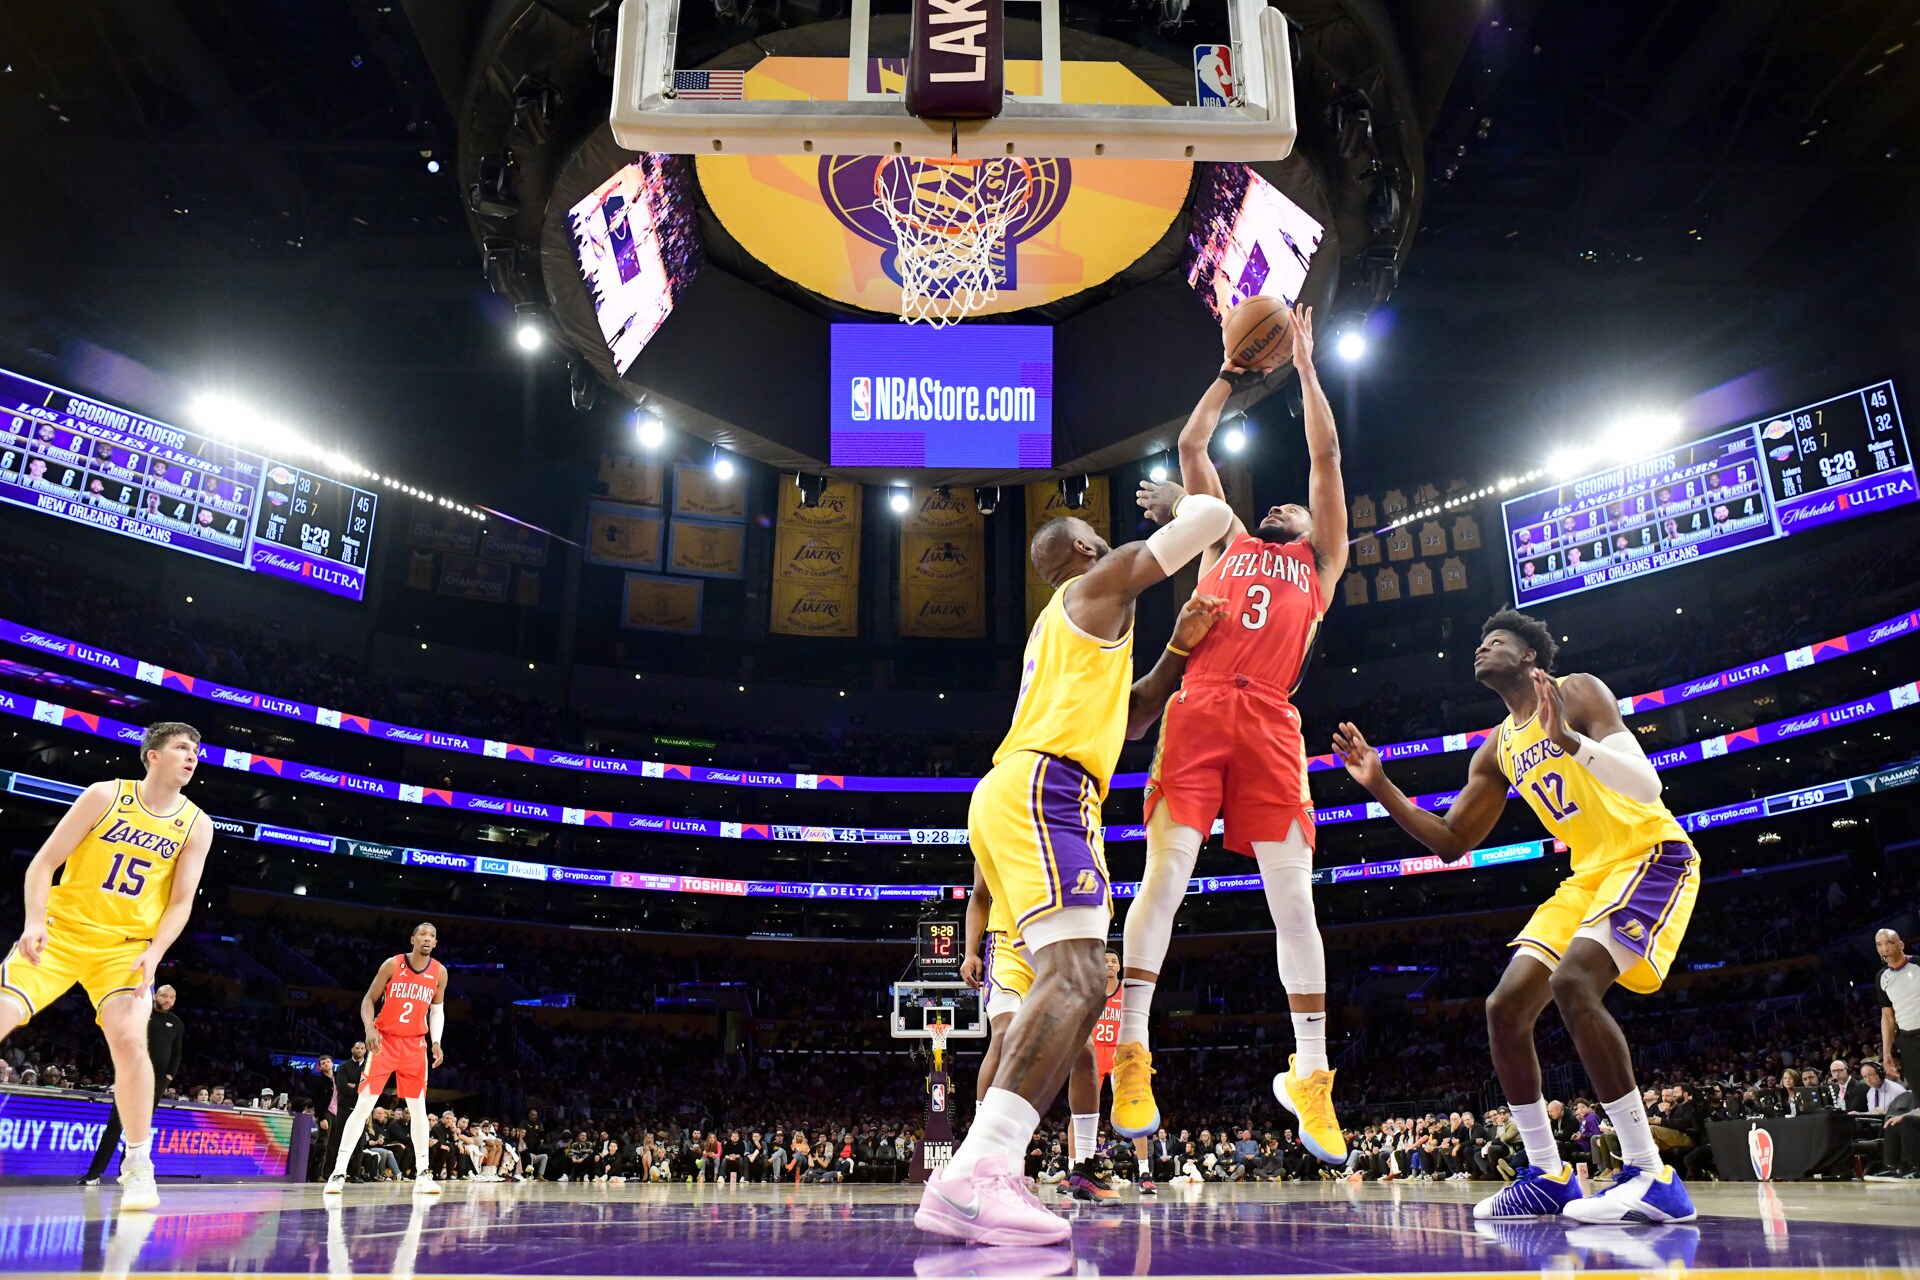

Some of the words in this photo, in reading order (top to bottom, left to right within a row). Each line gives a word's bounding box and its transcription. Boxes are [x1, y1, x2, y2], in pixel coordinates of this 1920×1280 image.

[928, 0, 987, 82] LAK
[1203, 97, 1221, 107] NBA
[1238, 323, 1283, 362] Wilson
[875, 376, 1036, 422] NBAStore.com
[1870, 390, 1887, 408] 45
[9, 416, 25, 434] 9
[66, 398, 129, 432] SCORING
[128, 419, 186, 450] LEADERS
[1796, 414, 1812, 432] 38
[1816, 410, 1823, 425] 7
[1875, 413, 1893, 432] 32
[16, 403, 59, 421] LOS
[59, 418, 148, 450] ANGELES
[148, 446, 224, 475] LAKERS
[70, 435, 84, 453] 8
[1801, 436, 1817, 454] 25
[1820, 432, 1828, 448] 7
[0, 451, 15, 469] 6
[126, 454, 139, 470] 8
[1819, 450, 1857, 478] 9:28
[62, 469, 76, 487] 6
[107, 464, 135, 481] JAMES
[181, 470, 193, 487] 6
[1574, 468, 1624, 499] SCORING
[1625, 454, 1676, 482] LEADERS
[1737, 465, 1747, 483] 5
[1826, 473, 1852, 486] QUARTER
[154, 479, 182, 498] BROWN
[232, 486, 244, 503] 5
[298, 477, 311, 494] 38
[1542, 503, 1573, 521] LOS
[1575, 481, 1646, 511] ANGELES
[1649, 459, 1718, 489] LAKERS
[1685, 481, 1695, 498] 6
[1723, 483, 1753, 499] BEASLEY
[119, 486, 132, 504] 5
[1781, 500, 1835, 526] Michelob
[1849, 478, 1914, 507] ULTRA
[174, 503, 187, 520] 4
[213, 496, 244, 515] BEASLEY
[294, 498, 307, 514] 25
[357, 496, 370, 513] 45
[920, 496, 967, 513] LAKERS
[1636, 496, 1645, 513] 8
[1665, 502, 1692, 516] BROWN
[1744, 498, 1754, 515] 4
[37, 494, 67, 518] NEW
[69, 502, 119, 533] ORLEANS
[121, 518, 172, 544] PELICANS
[792, 510, 813, 525] WORLD
[813, 513, 847, 525] CHAMPIONS
[1356, 509, 1371, 519] 22
[1588, 510, 1597, 526] 8
[1691, 513, 1702, 530] 4
[225, 519, 238, 535] 4
[353, 516, 367, 534] 32
[1543, 525, 1552, 541] 9
[300, 523, 331, 548] 9:28
[1425, 535, 1440, 546] 32
[1641, 528, 1651, 545] 5
[793, 545, 843, 565] LAKERS
[1361, 546, 1375, 556] 52
[1393, 541, 1408, 551] 33
[1593, 542, 1603, 558] 6
[252, 550, 301, 573] Michelob
[312, 565, 360, 590] ULTRA
[810, 566, 844, 577] CHAMPIONS
[1219, 549, 1311, 594] PELCANS
[1547, 555, 1556, 571] 6
[1584, 567, 1606, 587] NEW
[1608, 557, 1651, 579] ORLEANS
[1652, 545, 1699, 568] PELICANS
[790, 598, 841, 618] LAKERS
[917, 599, 967, 620] LAKERS
[1241, 584, 1272, 630] 3
[1868, 619, 1909, 642] Michelob
[20, 631, 67, 651] Michelob
[77, 648, 120, 669] ULTRA
[1682, 678, 1719, 698] Michelob
[1728, 663, 1770, 684] ULTRA
[211, 688, 252, 704] Michelob
[262, 698, 301, 716] ULTRA
[1777, 716, 1820, 737] Michelob
[1830, 702, 1875, 723] ULTRA
[386, 727, 423, 742] Michelob
[432, 734, 469, 750] ULTRA
[1393, 743, 1429, 756] ULTRA
[549, 754, 584, 767] Michelob
[592, 759, 628, 772] ULTRA
[300, 768, 339, 785] Michelob
[348, 777, 385, 794] ULTRA
[706, 771, 740, 782] Michelob
[748, 775, 783, 785] ULTRA
[1531, 771, 1580, 822] 12
[1789, 790, 1824, 808] 7:50
[468, 798, 504, 811] Michelob
[513, 803, 549, 817] ULTRA
[1318, 808, 1353, 822] ULTRA
[1710, 804, 1758, 822] crypto.com
[629, 817, 664, 829] Michelob
[672, 821, 707, 832] ULTRA
[99, 818, 180, 859] LAKERS
[262, 830, 299, 842] AMERICAN
[299, 836, 330, 847] EXPRESS
[839, 830, 857, 843] 45
[874, 832, 902, 842] Lakers
[916, 830, 950, 844] 9:28
[412, 851, 467, 868] Spectrum
[1482, 846, 1532, 861] mobilitie
[101, 852, 152, 898] 15
[484, 862, 506, 872] UCLA
[511, 864, 541, 876] Health
[564, 871, 606, 881] crypto.com
[1369, 864, 1400, 875] ULTRA
[683, 879, 743, 893] TOSHIBA
[781, 885, 809, 894] ULTRA
[831, 887, 872, 896] DELTA
[1219, 878, 1261, 888] crypto.com
[930, 925, 954, 937] 9:28
[933, 937, 951, 956] 12
[390, 982, 435, 1005] PELICANS
[399, 1002, 414, 1024] 2
[1096, 1023, 1115, 1043] 25
[0, 1118, 46, 1150] BUY
[158, 1128, 256, 1156] LAKERS.COM
[923, 1145, 953, 1160] BLACK
